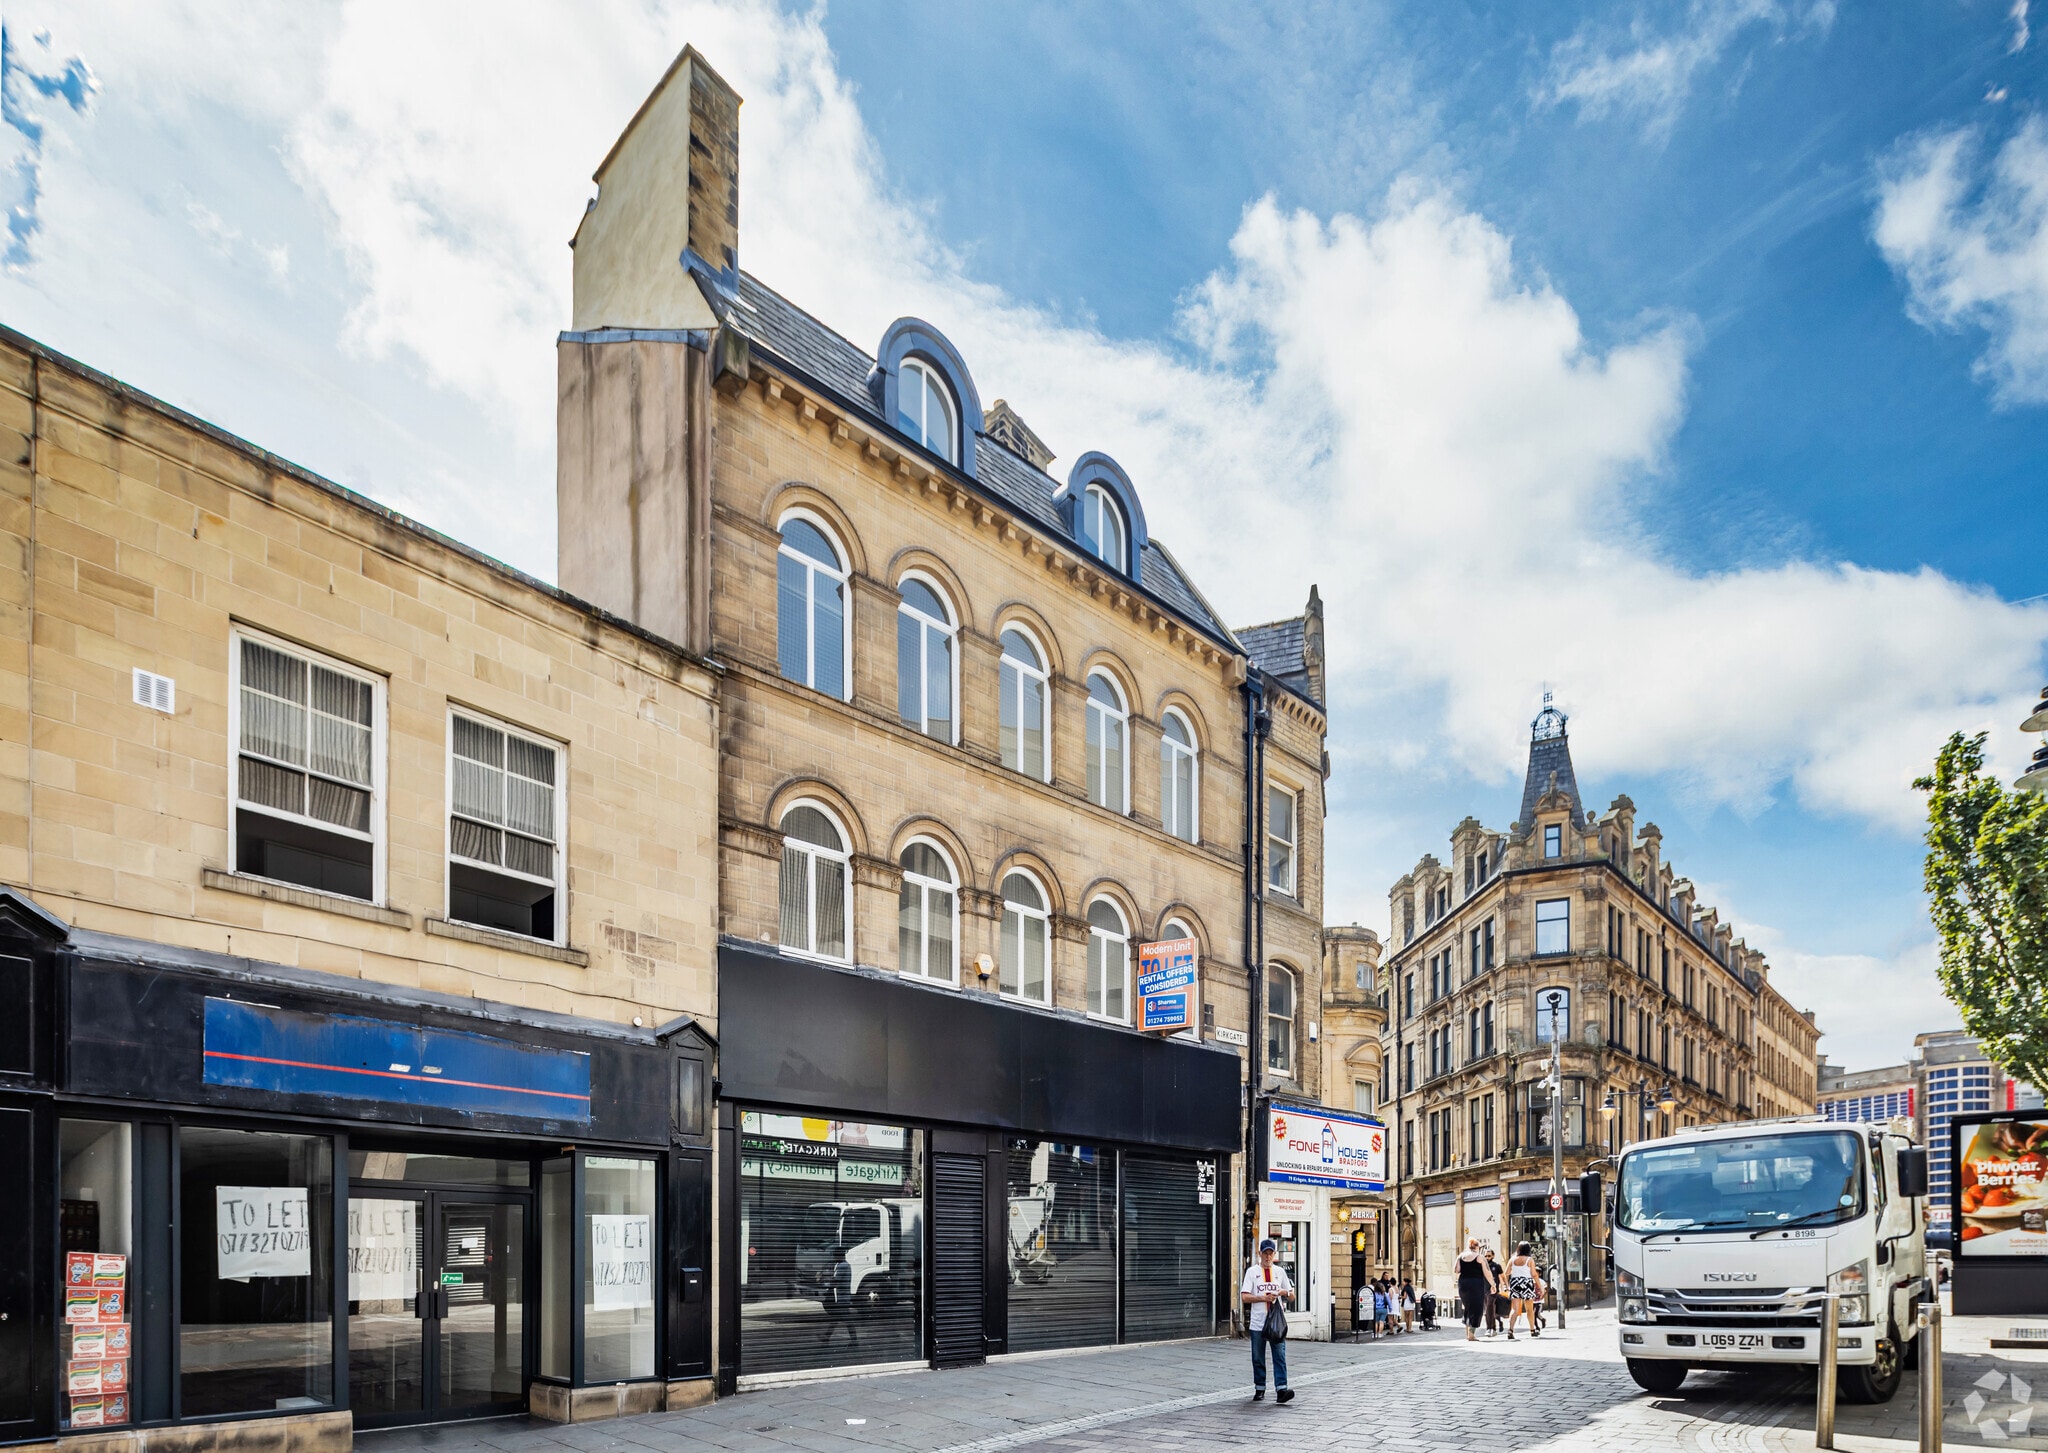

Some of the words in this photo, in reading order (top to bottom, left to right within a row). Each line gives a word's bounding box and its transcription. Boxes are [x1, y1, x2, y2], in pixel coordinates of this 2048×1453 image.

[1143, 945, 1172, 955] Modern
[1174, 942, 1191, 952] Unit
[1140, 972, 1165, 986] RENTAL
[1166, 965, 1192, 978] OFFERS
[1145, 976, 1188, 993] CONSIDERED
[1216, 1030, 1243, 1042] KIRKGATE
[1289, 1139, 1320, 1153] FONE
[1338, 1147, 1368, 1160] HOUSE
[1276, 1161, 1302, 1170] UNLOCKING
[1339, 1157, 1368, 1167] BRADFORD
[1976, 1161, 2041, 1173] Phwoar.
[1977, 1173, 2040, 1186] Berries.
[222, 1200, 255, 1229] TO
[268, 1200, 308, 1228] LET
[370, 1209, 410, 1236] LET
[592, 1223, 607, 1244] TO
[613, 1221, 647, 1249] LET
[1704, 1272, 1757, 1282] ISUZU
[1702, 1334, 1735, 1346] LO69
[1739, 1335, 1764, 1346] ZZH
